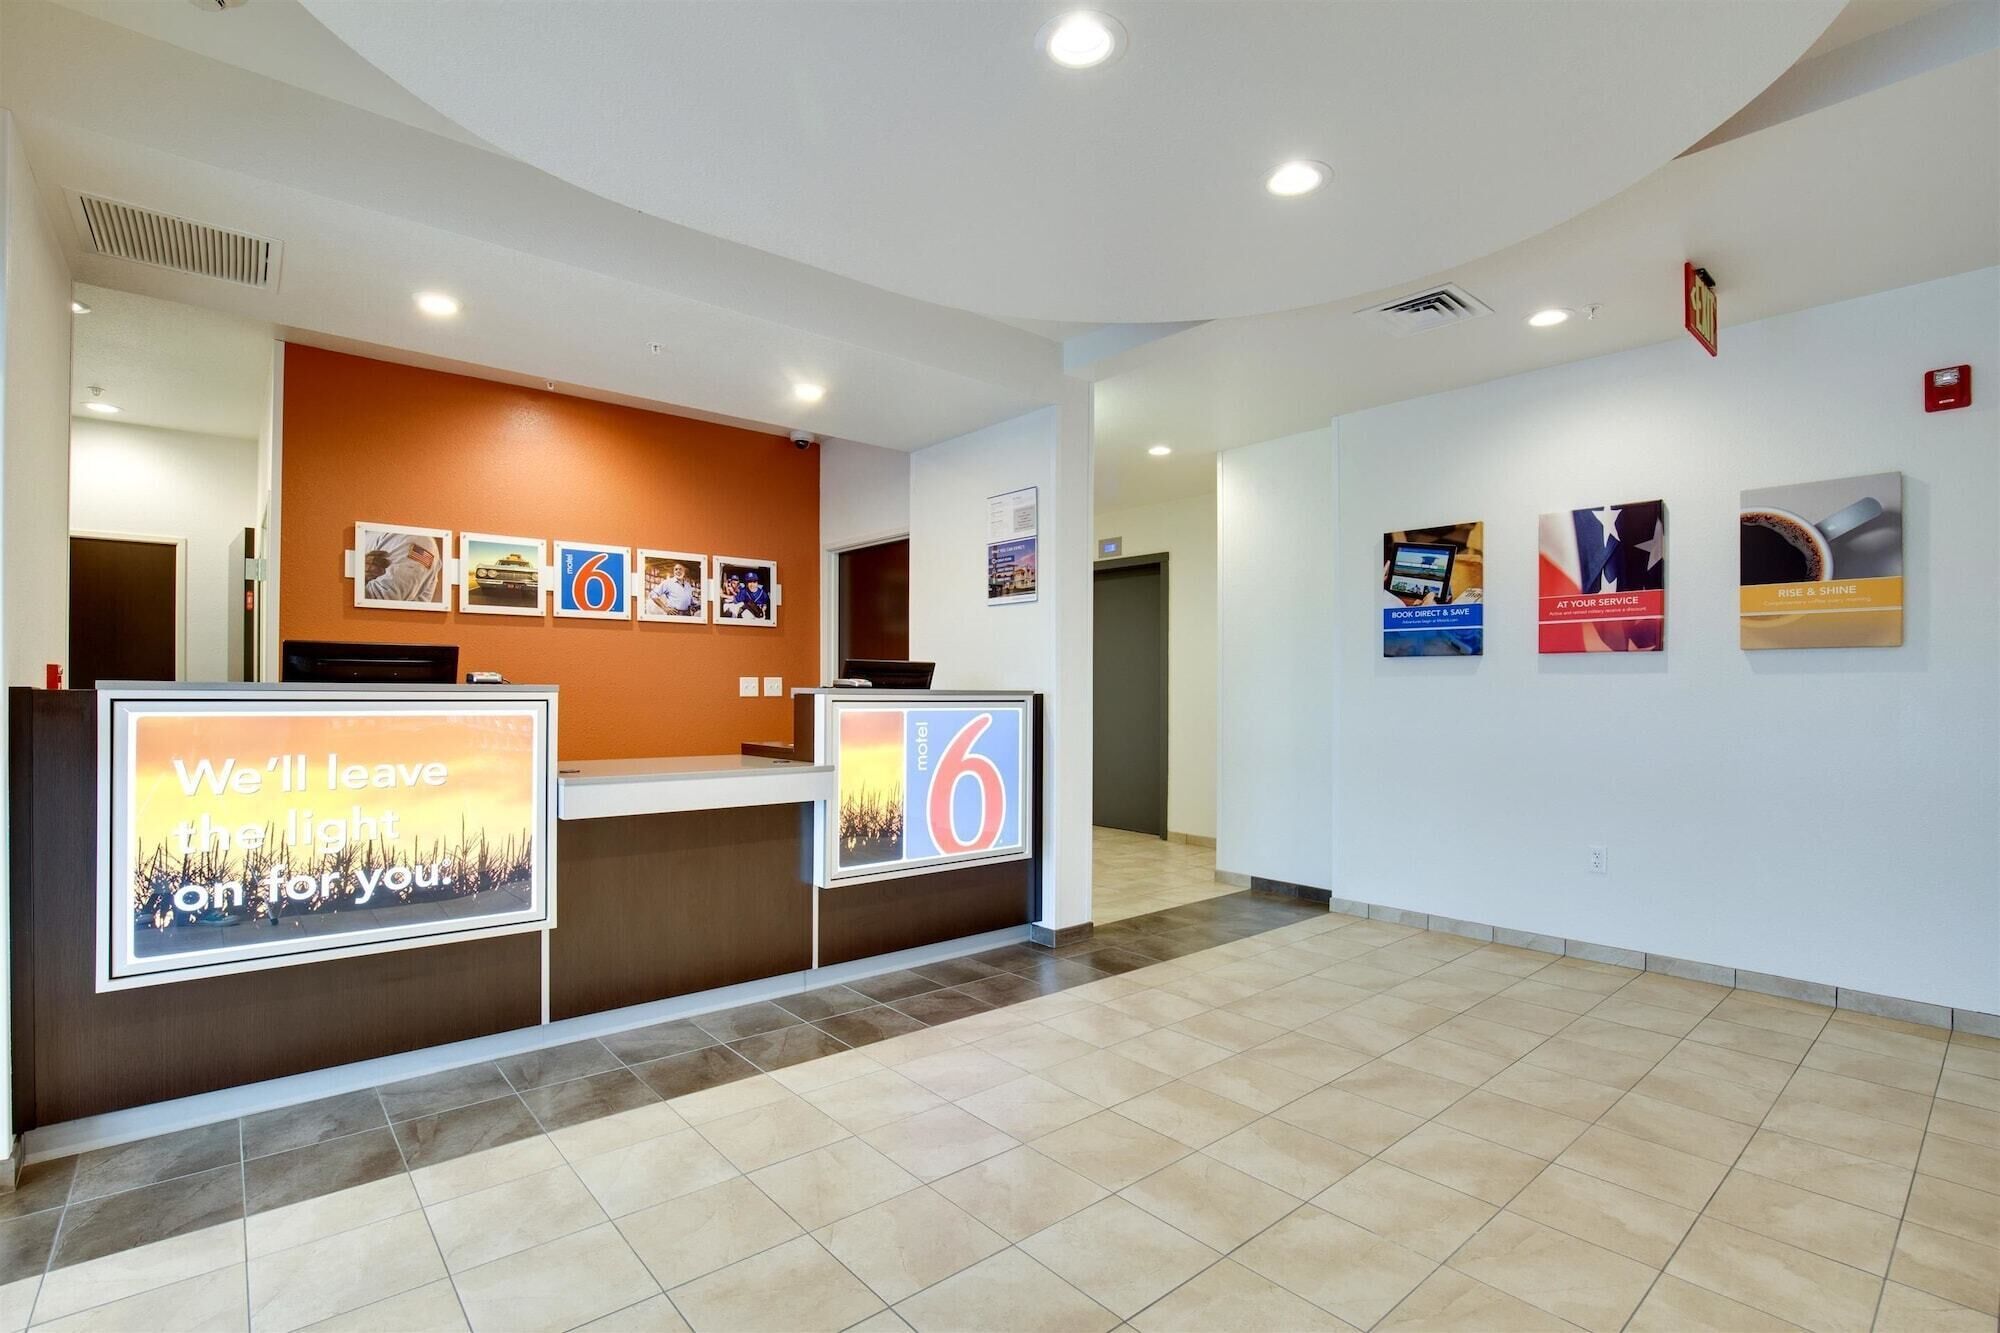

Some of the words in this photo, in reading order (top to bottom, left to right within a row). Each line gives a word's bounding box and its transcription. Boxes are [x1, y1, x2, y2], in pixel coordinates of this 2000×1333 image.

[565, 553, 574, 575] motel
[571, 552, 618, 611] 6
[1556, 600, 1569, 609] AT
[1570, 599, 1597, 608] YOUR
[1598, 596, 1639, 606] SERVICE
[1777, 588, 1803, 598] RISE
[1806, 587, 1816, 596] &
[1819, 585, 1857, 595] SHINE
[1391, 611, 1414, 619] BOOK
[1414, 609, 1441, 618] DIRECT
[1450, 608, 1470, 616] SAVE
[173, 754, 306, 797] We'll
[327, 753, 449, 790] leave
[916, 721, 929, 771] motel
[926, 712, 1007, 856] 6
[172, 814, 265, 855] the
[287, 805, 400, 855] light
[173, 878, 244, 912] on
[264, 863, 340, 903] for
